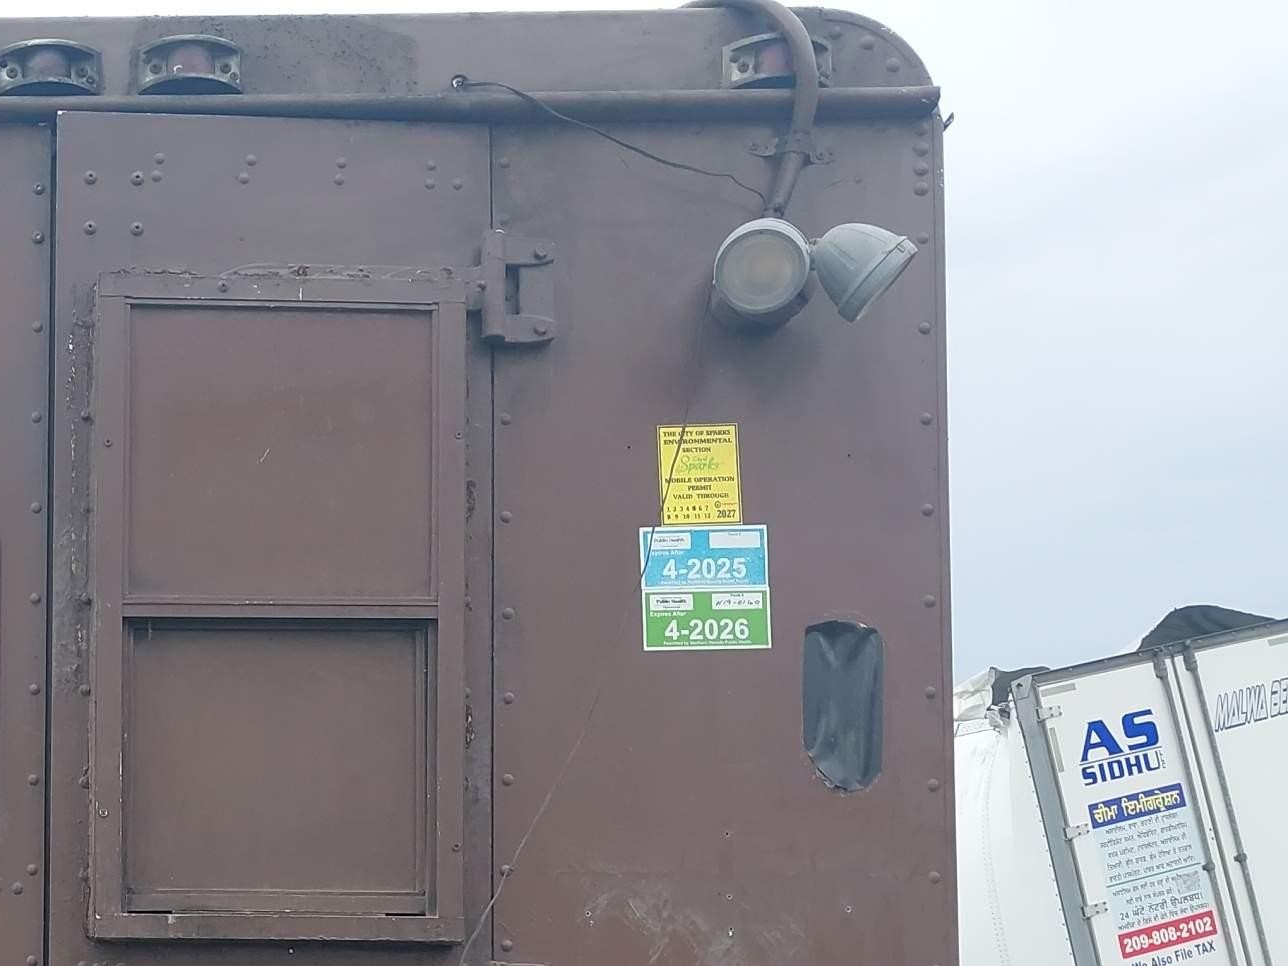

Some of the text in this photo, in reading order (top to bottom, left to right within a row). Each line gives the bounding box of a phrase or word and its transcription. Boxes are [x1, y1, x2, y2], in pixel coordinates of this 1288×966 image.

[663, 437, 733, 445] ENVRONMENTAL
[680, 454, 720, 474] Sparks
[716, 509, 736, 518] 2027
[662, 557, 747, 579] 4-2025
[664, 618, 750, 641] 4-2026
[1215, 683, 1268, 732] MALWA
[1080, 709, 1159, 762] AS
[1081, 751, 1161, 786] SIDHU
[1119, 911, 1129, 921] 24
[1123, 916, 1214, 953] 209-808-2102
[1174, 948, 1193, 962] File
[1194, 940, 1216, 956] TAX
